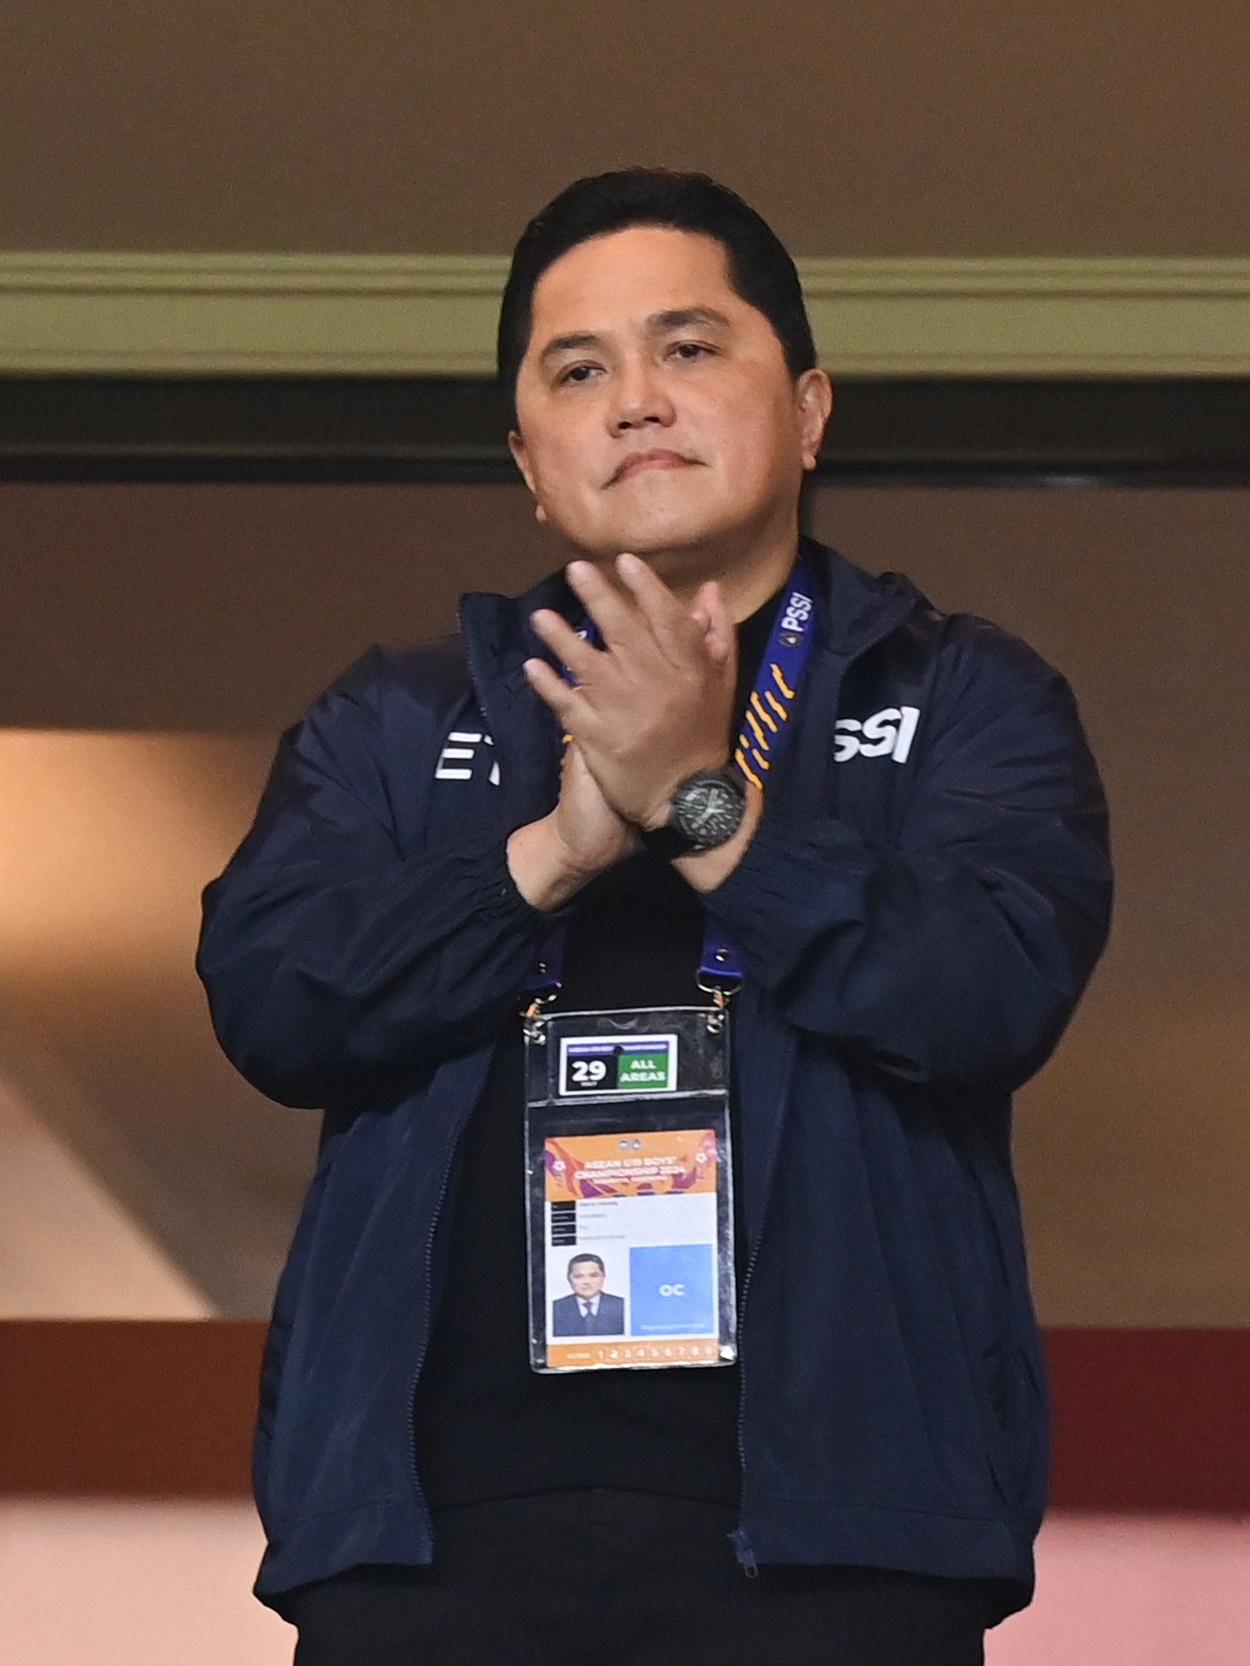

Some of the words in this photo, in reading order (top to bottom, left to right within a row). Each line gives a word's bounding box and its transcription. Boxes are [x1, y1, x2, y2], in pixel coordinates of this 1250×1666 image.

[781, 592, 813, 632] PSSI
[833, 705, 920, 764] SSI
[571, 1060, 607, 1082] 29
[630, 1059, 656, 1070] ALL
[620, 1071, 666, 1083] AREAS
[659, 1283, 685, 1297] OC
[598, 1350, 604, 1359] 1
[609, 1350, 619, 1359] 2
[624, 1349, 632, 1358] 3
[637, 1348, 645, 1358] 4
[678, 1346, 686, 1356] 7
